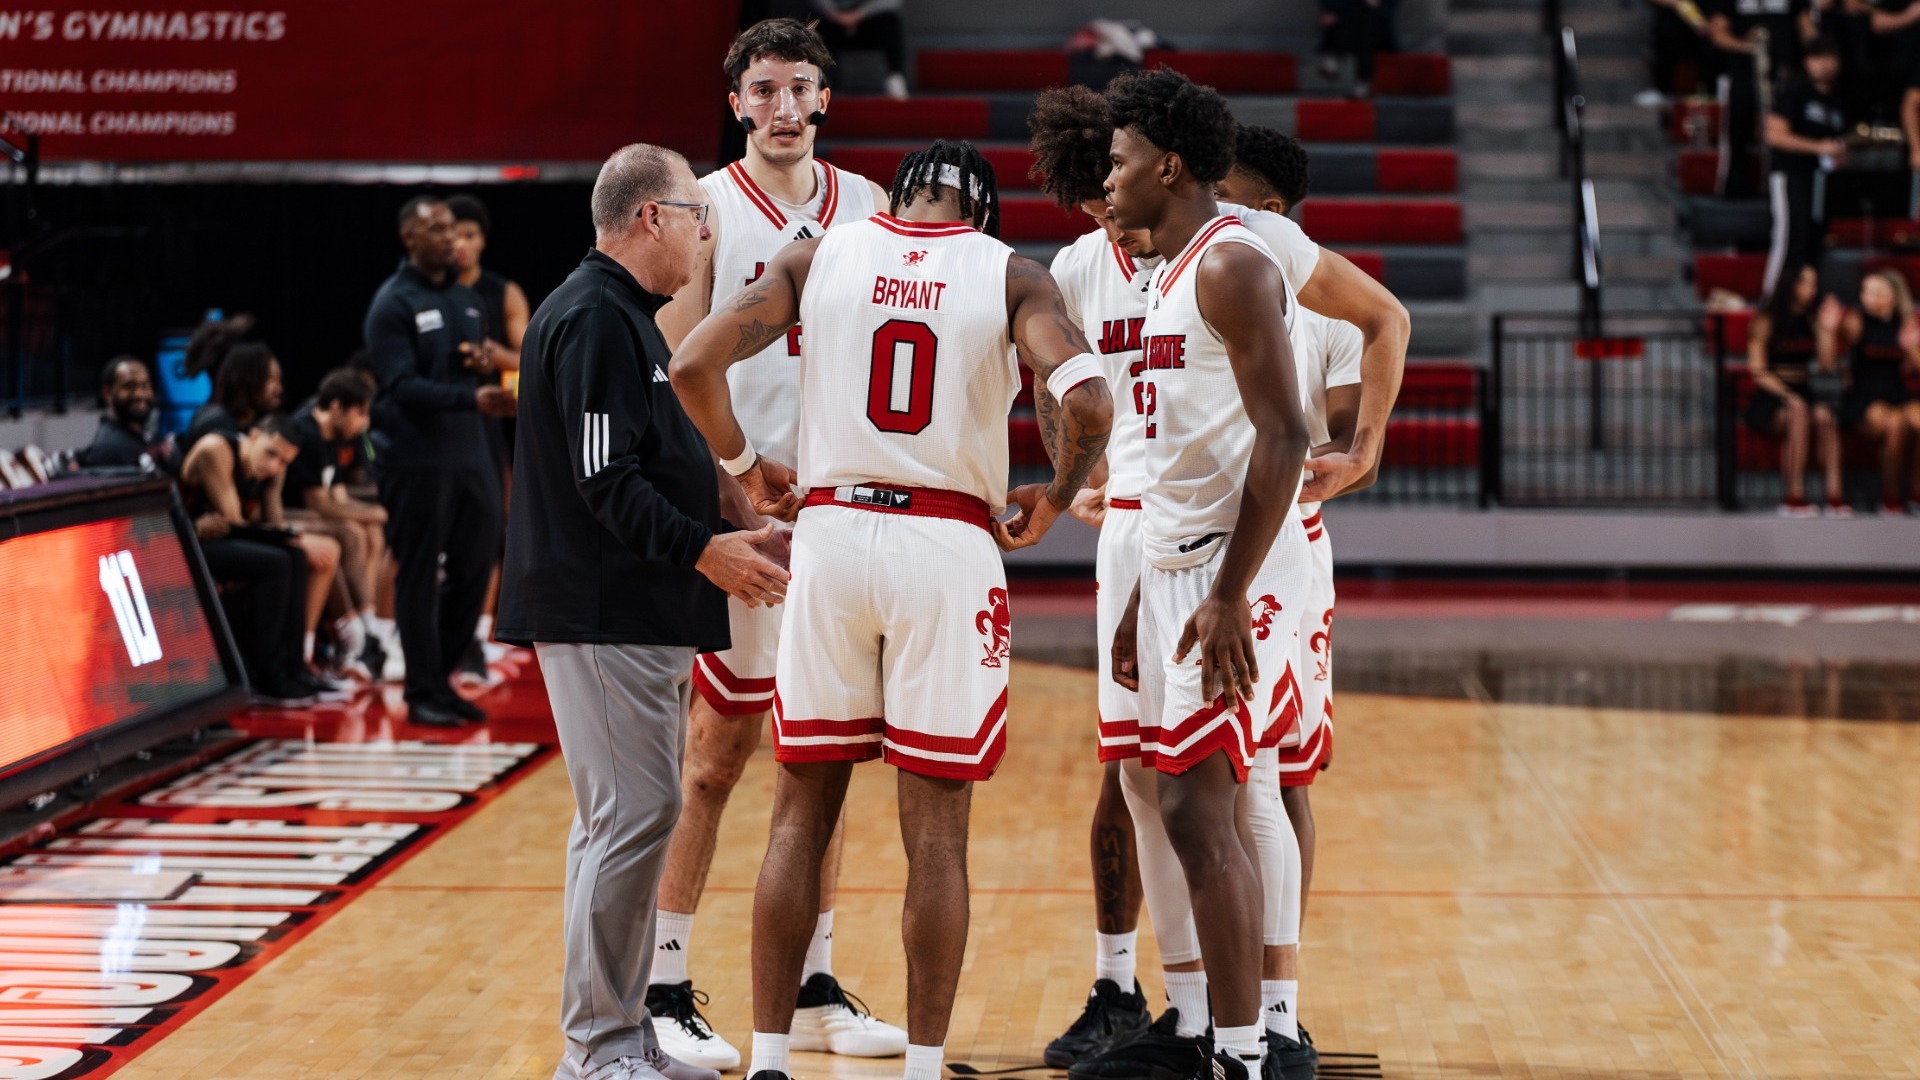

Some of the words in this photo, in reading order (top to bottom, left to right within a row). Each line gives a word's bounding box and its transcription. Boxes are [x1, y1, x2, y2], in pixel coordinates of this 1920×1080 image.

[62, 11, 287, 41] GYMNASTICS
[90, 69, 238, 94] CHAMPIONS
[89, 111, 237, 135] CHAMPIONS
[872, 275, 946, 311] BRYANT
[1097, 316, 1146, 355] JAX
[866, 318, 938, 436] 0
